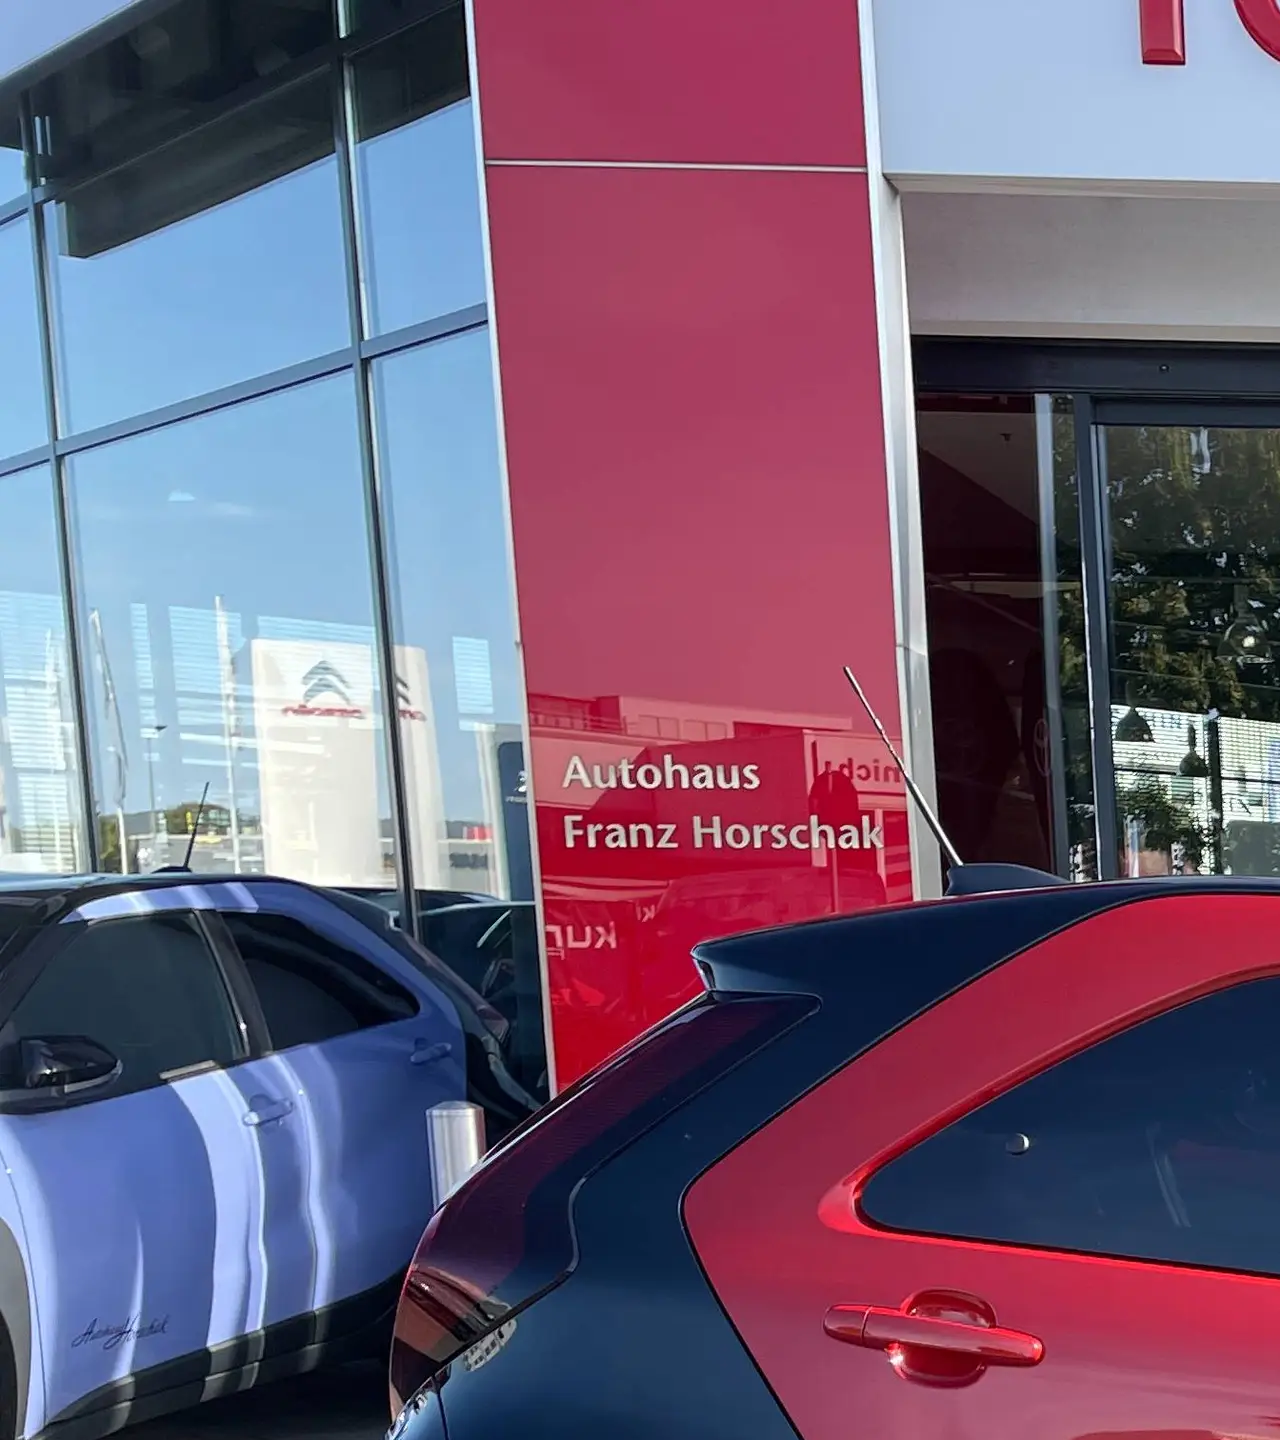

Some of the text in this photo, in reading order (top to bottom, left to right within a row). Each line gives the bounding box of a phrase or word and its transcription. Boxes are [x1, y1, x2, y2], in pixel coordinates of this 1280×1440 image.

[562, 753, 761, 790] Autohaus
[563, 814, 885, 849] Franz Horschak
